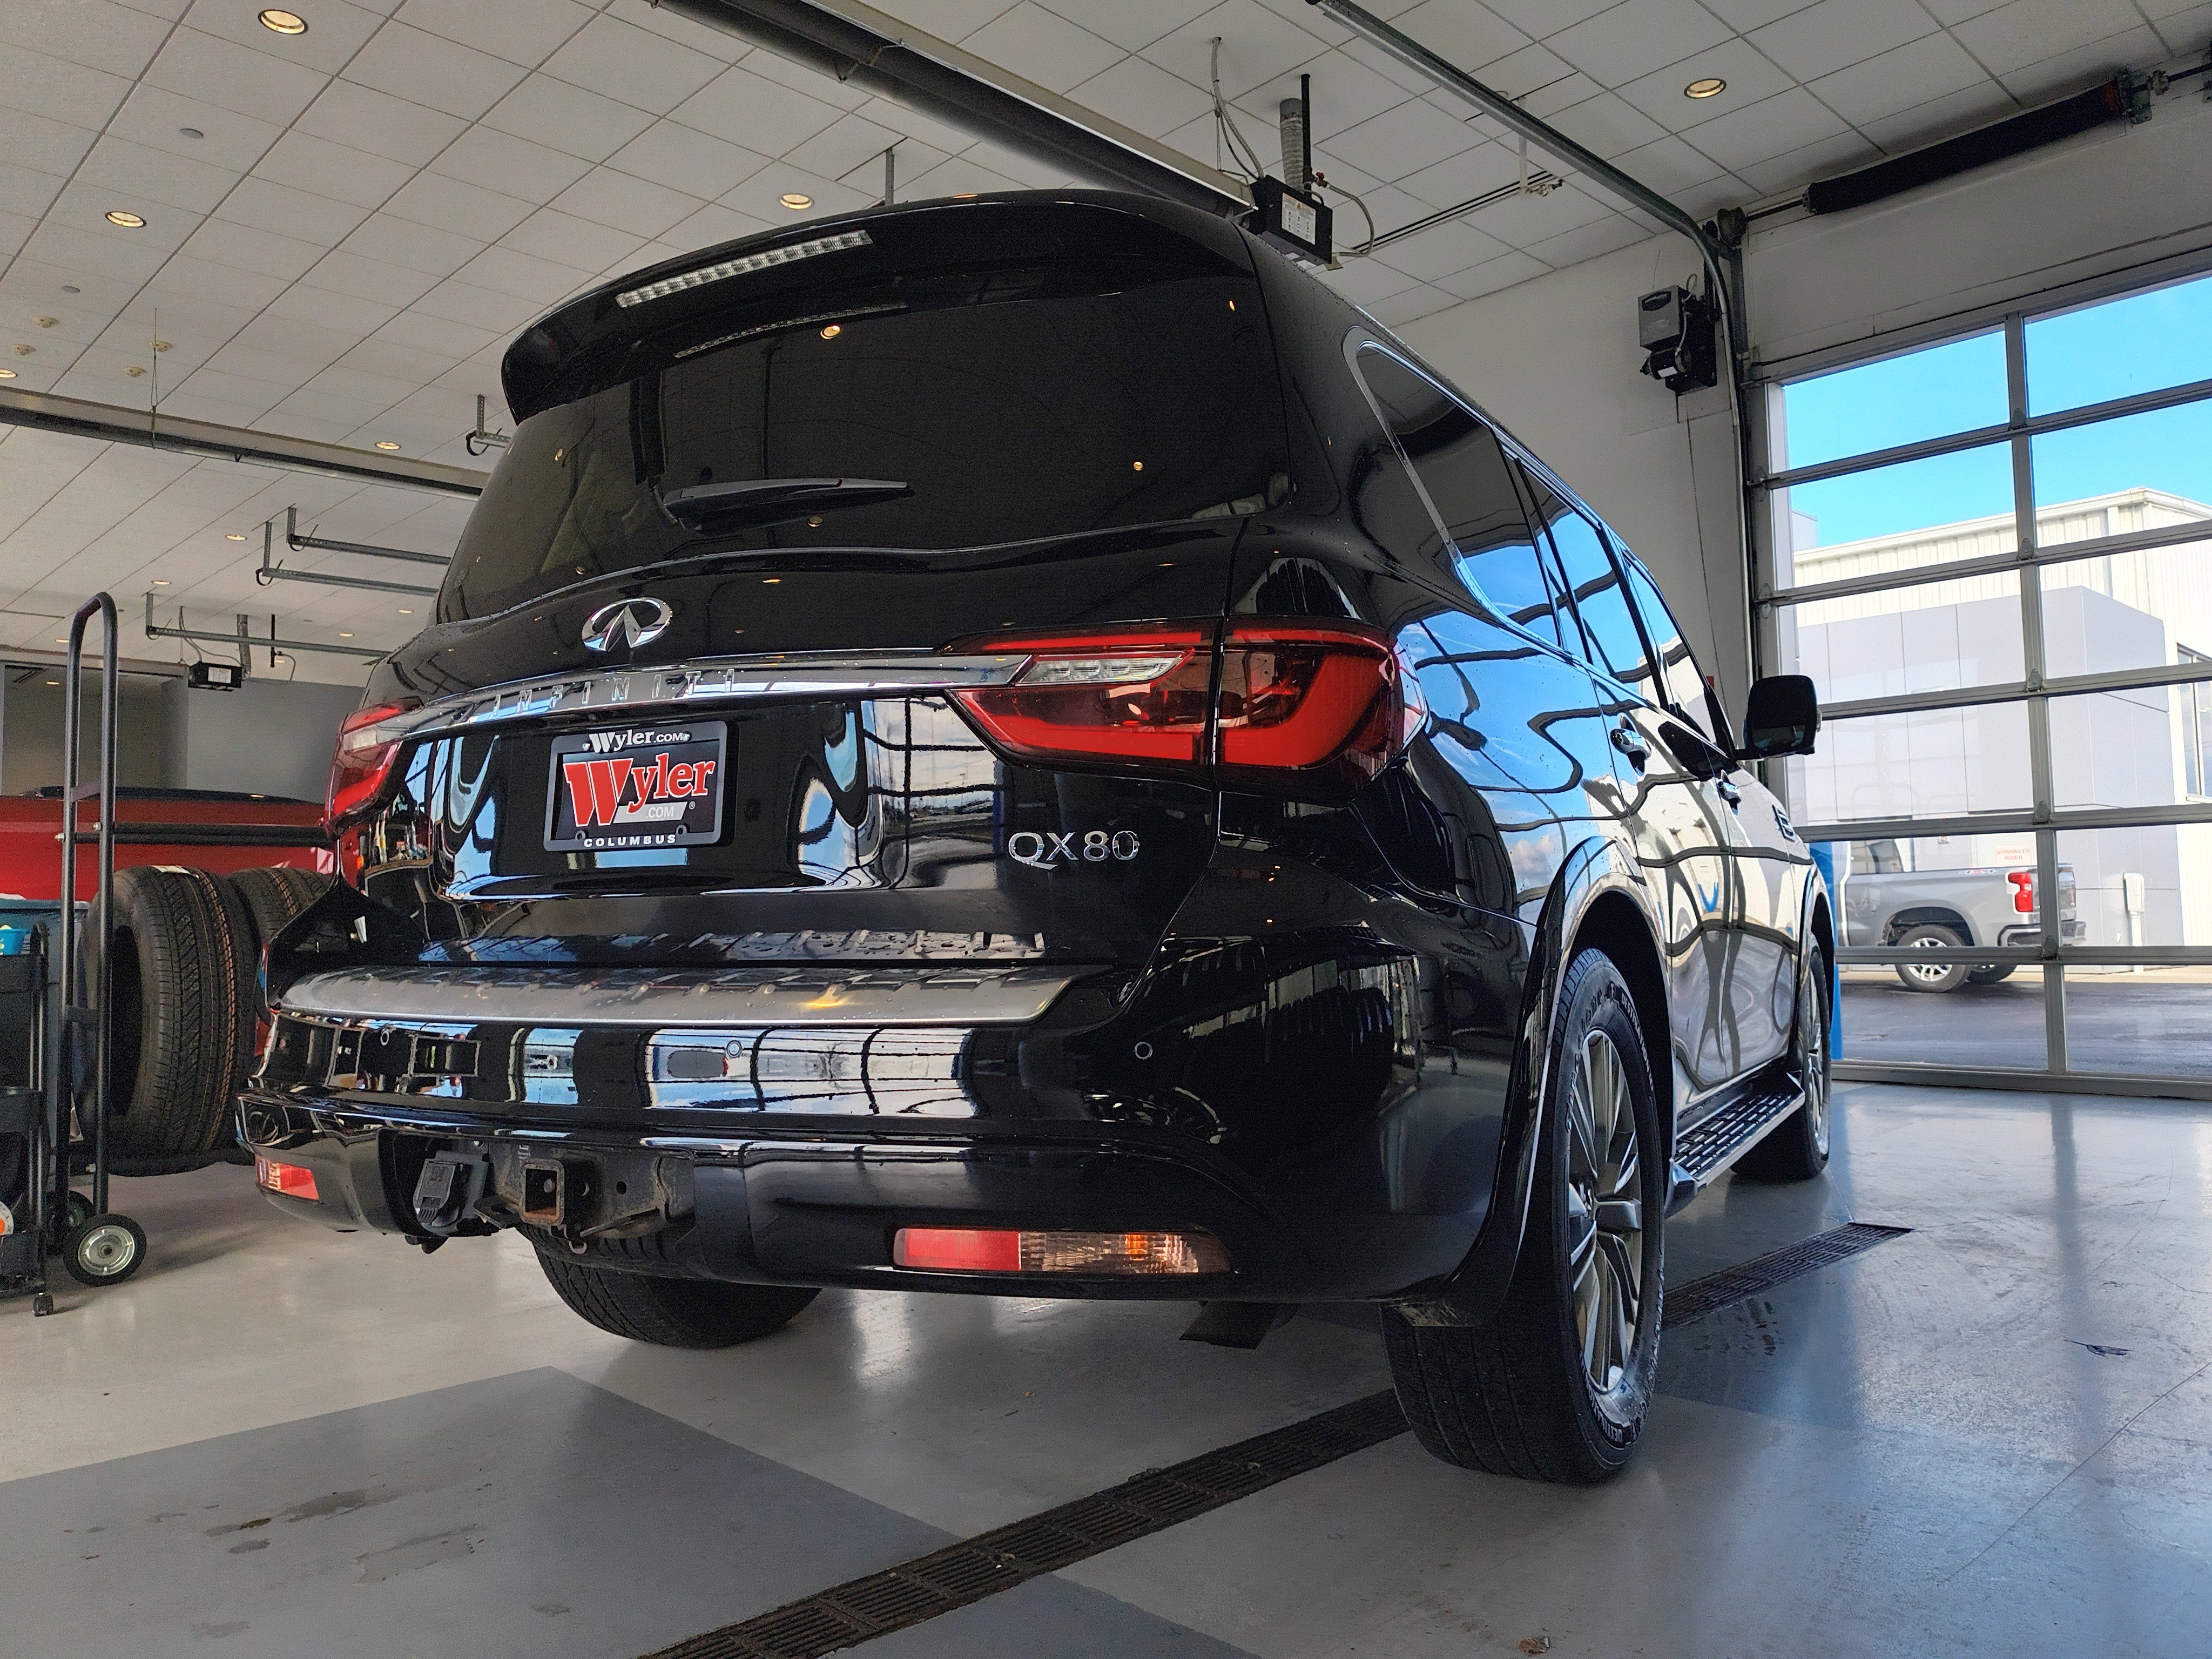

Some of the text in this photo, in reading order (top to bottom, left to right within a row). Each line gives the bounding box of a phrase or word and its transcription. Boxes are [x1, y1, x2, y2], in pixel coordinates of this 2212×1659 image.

[492, 669, 736, 716] INFINITI
[563, 752, 716, 827] Wyler
[583, 834, 676, 848] COLUMBUS
[1008, 831, 1140, 870] QX80
